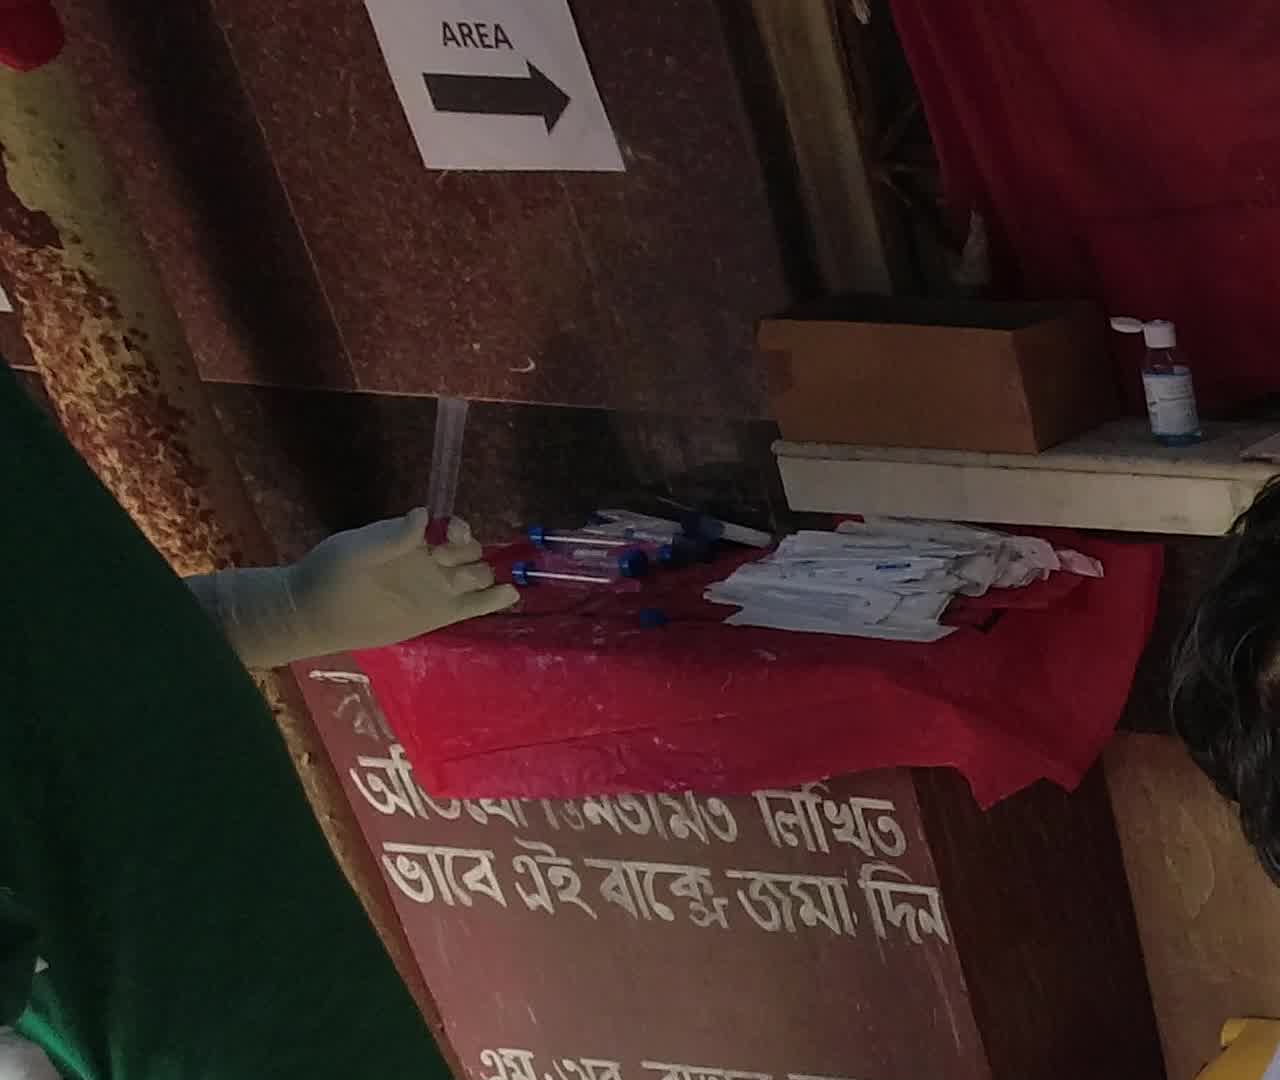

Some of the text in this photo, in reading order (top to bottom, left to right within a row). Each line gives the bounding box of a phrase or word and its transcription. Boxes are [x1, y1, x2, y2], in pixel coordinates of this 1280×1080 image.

[441, 21, 513, 51] AREA
[382, 841, 507, 908] ভাবে
[513, 837, 598, 919] এই
[726, 870, 857, 937] জমা
[858, 862, 950, 945] দিন
